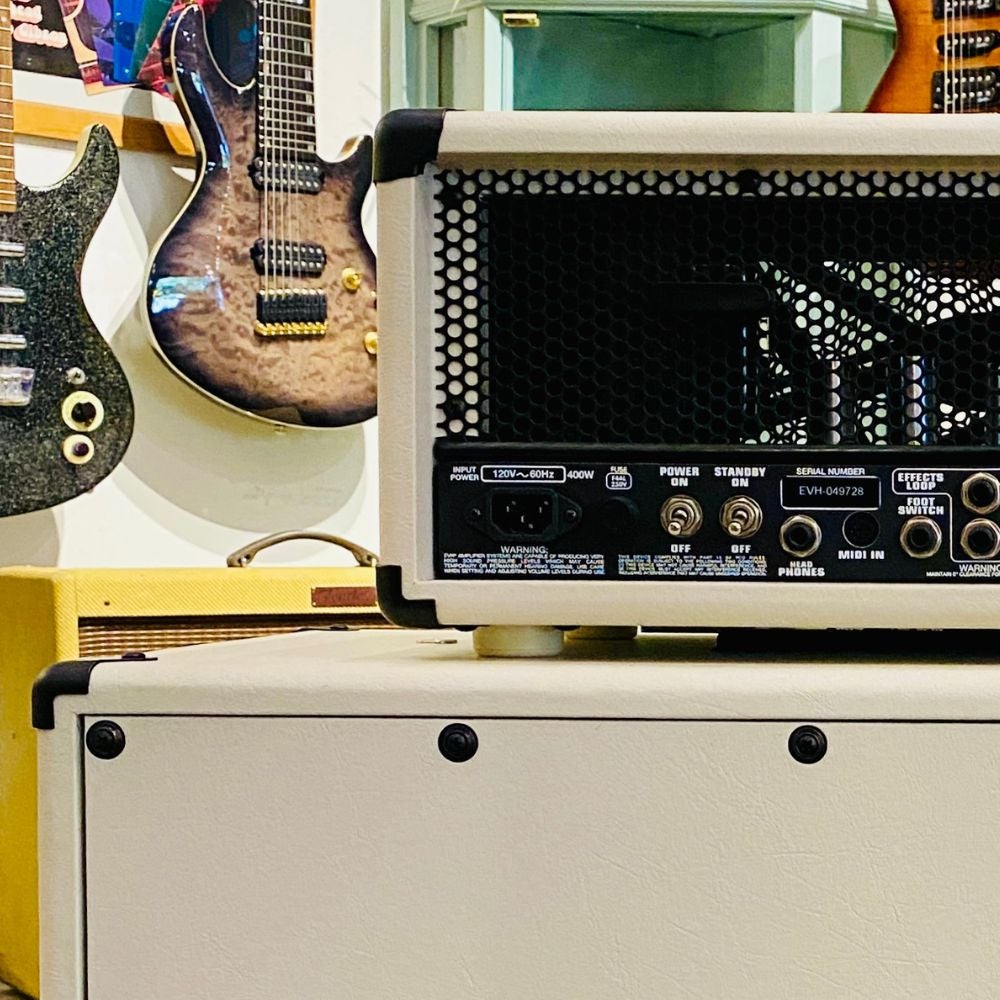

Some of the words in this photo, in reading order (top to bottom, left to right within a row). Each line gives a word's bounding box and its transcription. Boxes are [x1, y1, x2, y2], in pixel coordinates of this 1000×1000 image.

[611, 466, 627, 474] FUSE
[660, 467, 700, 476] POWER
[714, 467, 766, 477] STANDBY
[567, 471, 594, 479] 400W
[898, 473, 944, 482] EFFECTS
[671, 478, 688, 486] ON
[732, 478, 749, 487] ON
[906, 482, 936, 490] LOOP
[799, 486, 864, 496] EVH-049728
[907, 497, 935, 506] FOOT
[898, 506, 944, 515] SWITCH
[500, 546, 548, 554] WARNING:
[671, 544, 691, 553] OFF
[731, 545, 751, 554] OFF
[838, 551, 867, 559] MIDI
[871, 551, 884, 559] IN
[778, 568, 825, 576] PHONES
